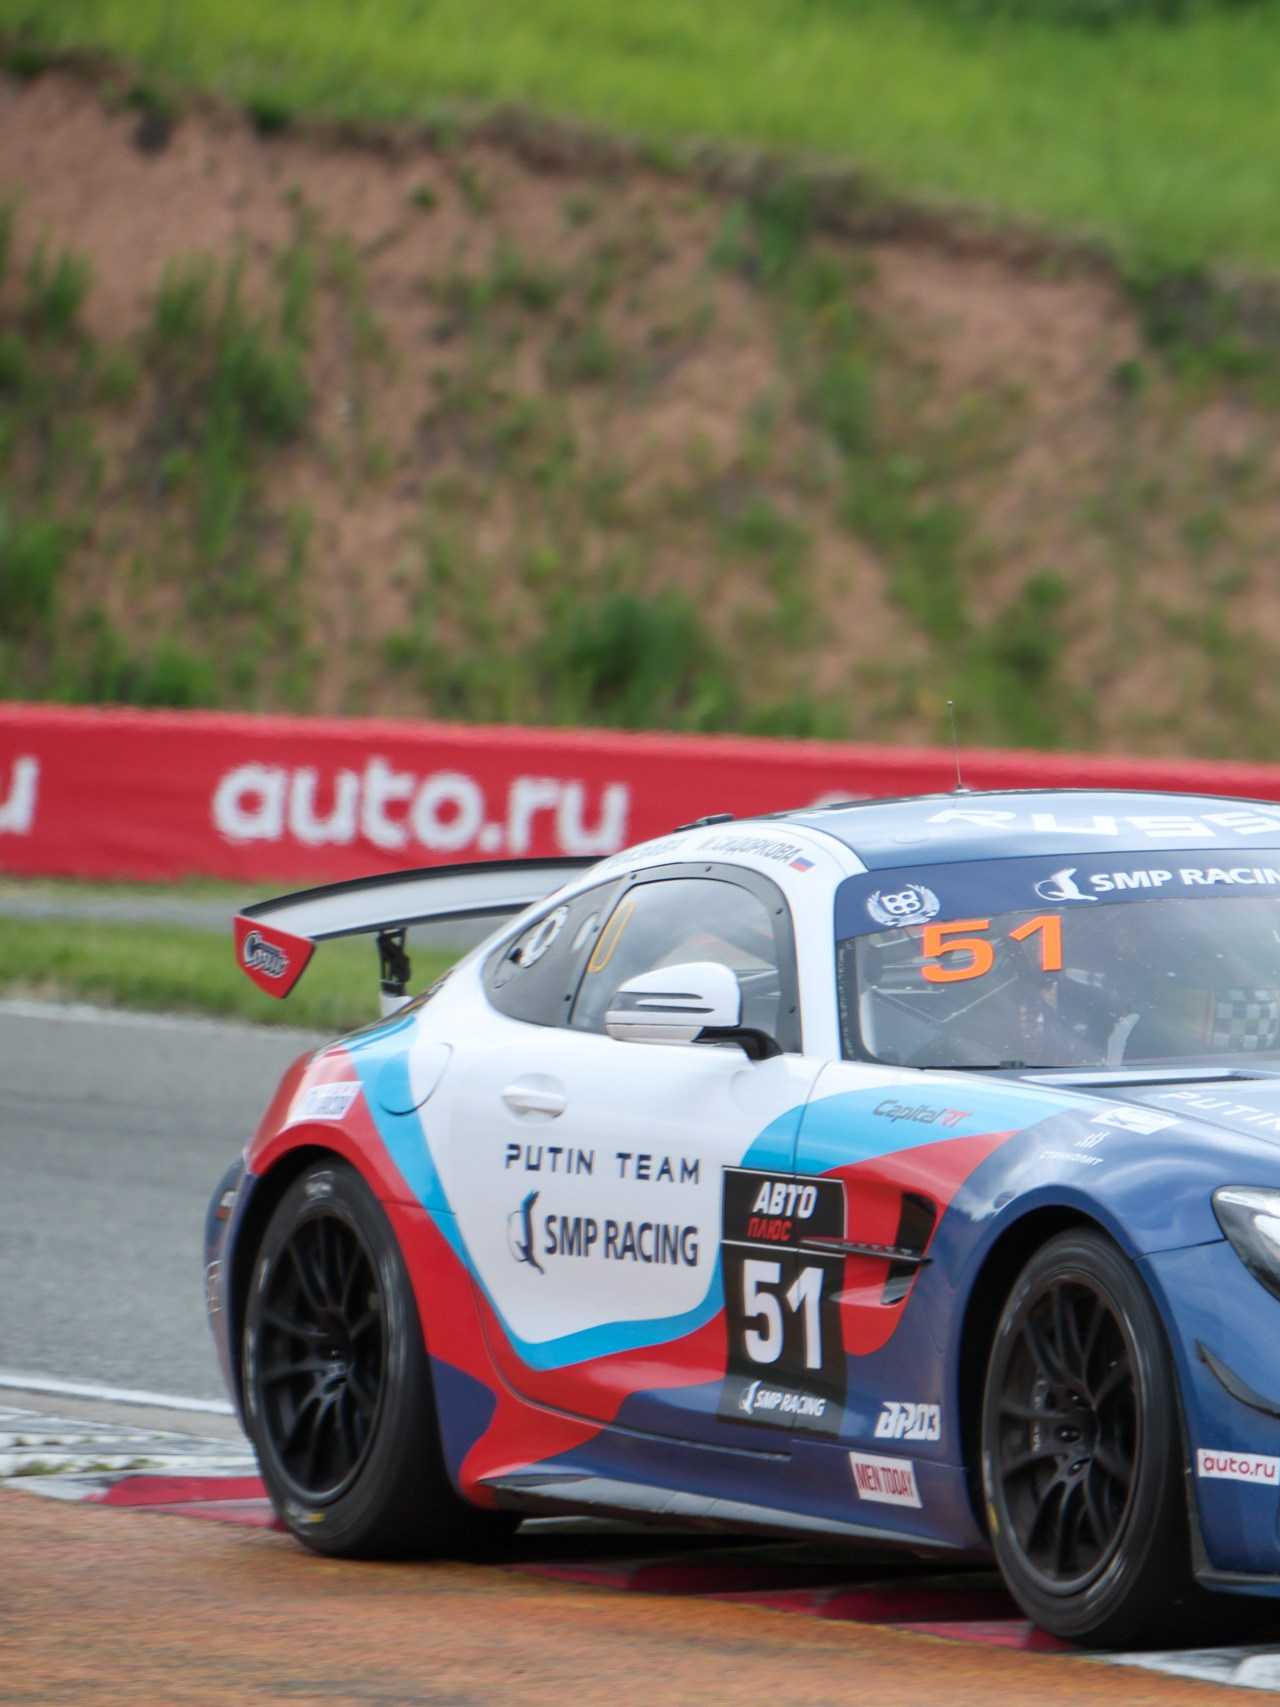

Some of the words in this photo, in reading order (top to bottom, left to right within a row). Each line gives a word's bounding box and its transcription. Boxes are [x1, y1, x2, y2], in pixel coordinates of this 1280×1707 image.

[212, 755, 629, 855] auto.ru
[1090, 869, 1172, 891] SMP
[921, 915, 1063, 983] 51
[505, 1143, 595, 1175] PUTIN
[616, 1152, 700, 1185] TEAM
[752, 1181, 818, 1219] АВТО
[544, 1214, 598, 1257] SMP
[604, 1219, 698, 1267] RACING
[747, 1217, 792, 1242] ПЛЮС
[742, 1259, 825, 1369] 51
[753, 1390, 783, 1410] SMP
[780, 1394, 827, 1416] RACING
[855, 1463, 882, 1493] MEN
[881, 1467, 915, 1498] TODAY
[1203, 1454, 1276, 1479] auto.ru
